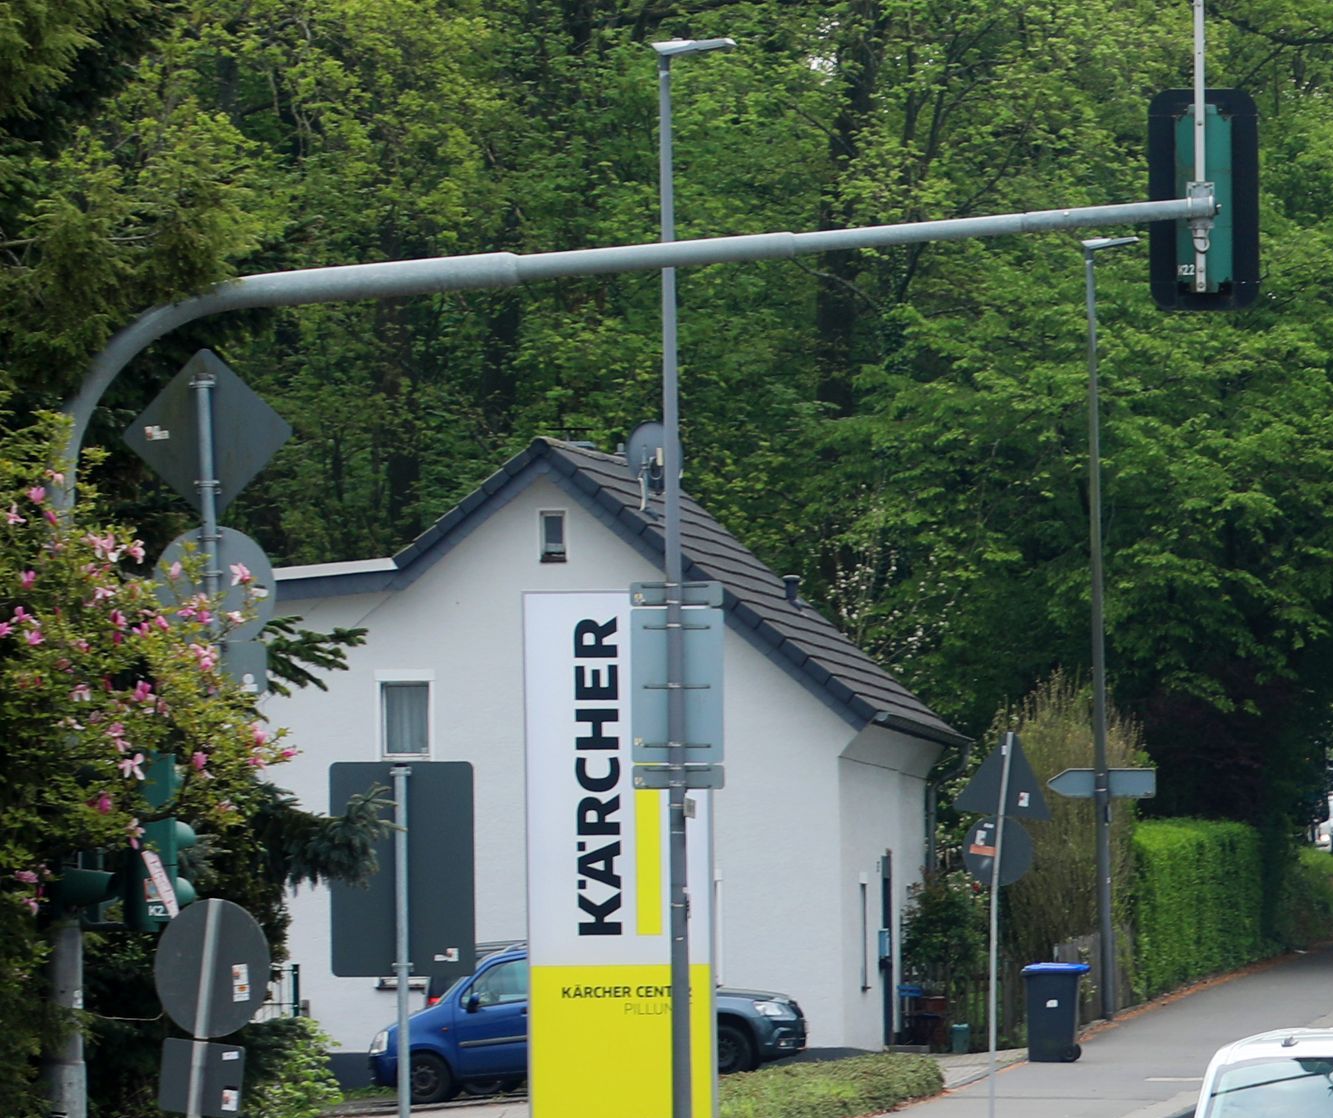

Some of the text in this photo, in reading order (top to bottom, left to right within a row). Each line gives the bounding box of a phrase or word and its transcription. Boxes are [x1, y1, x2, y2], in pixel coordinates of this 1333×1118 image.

[573, 616, 623, 936] KÄRCHER
[561, 984, 692, 999] KÄRCHER CENT
